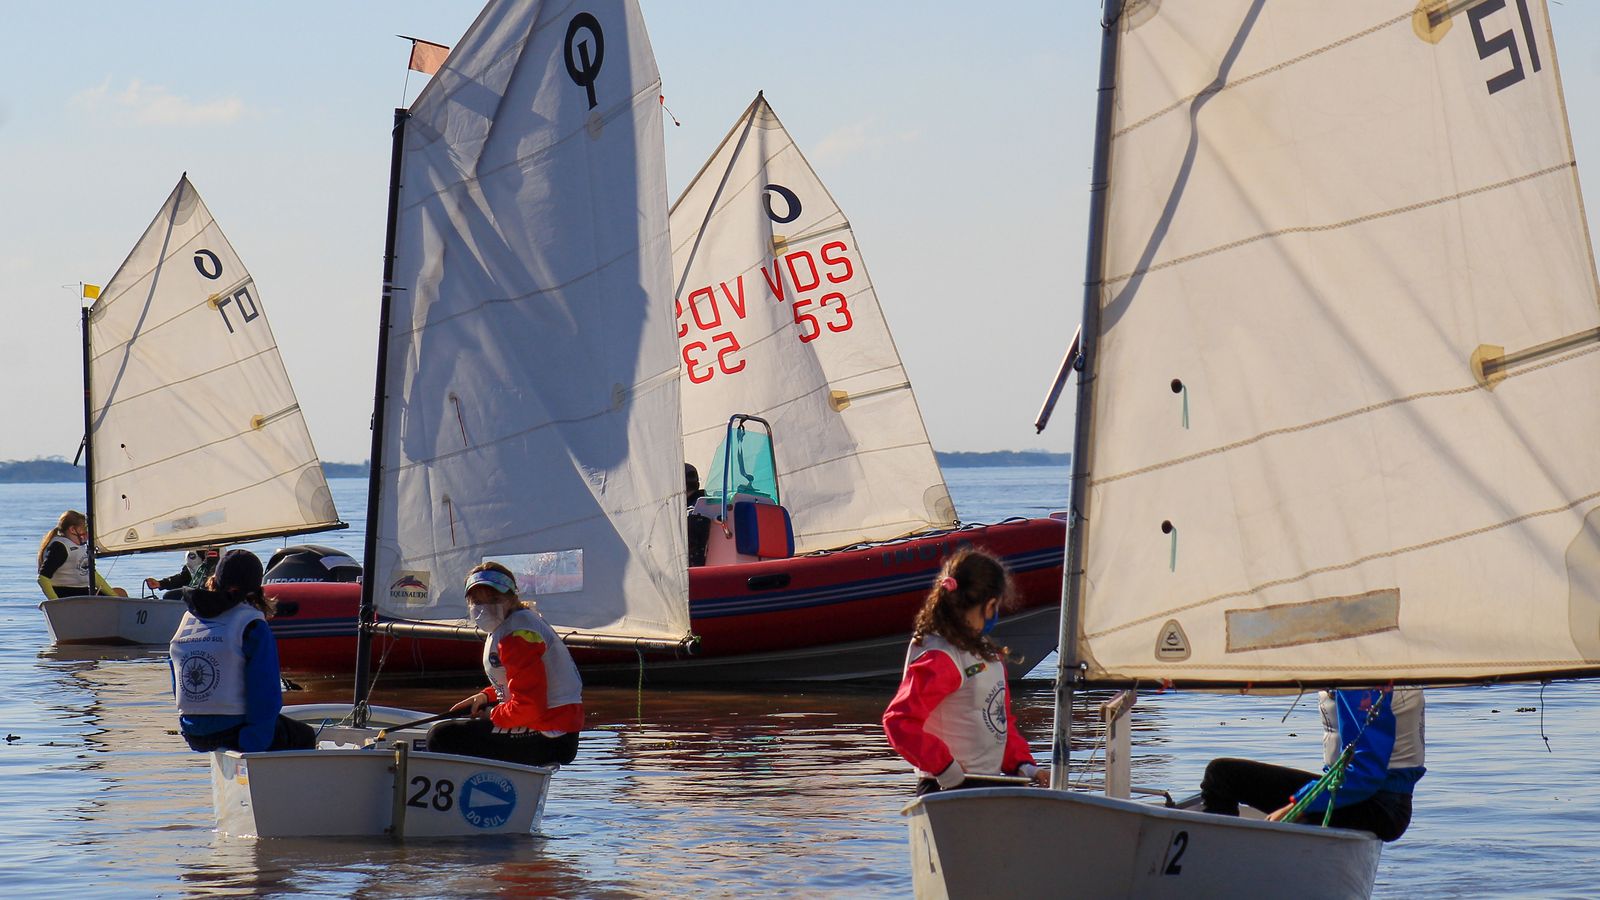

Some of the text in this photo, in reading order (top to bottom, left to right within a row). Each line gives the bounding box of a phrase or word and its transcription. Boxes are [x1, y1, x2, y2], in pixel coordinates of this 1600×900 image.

[761, 241, 854, 303] VDS
[792, 292, 853, 343] 53
[136, 609, 148, 625] 10
[407, 775, 455, 812] 28
[470, 774, 512, 793] VELEIROS
[466, 810, 505, 828] DO SUL
